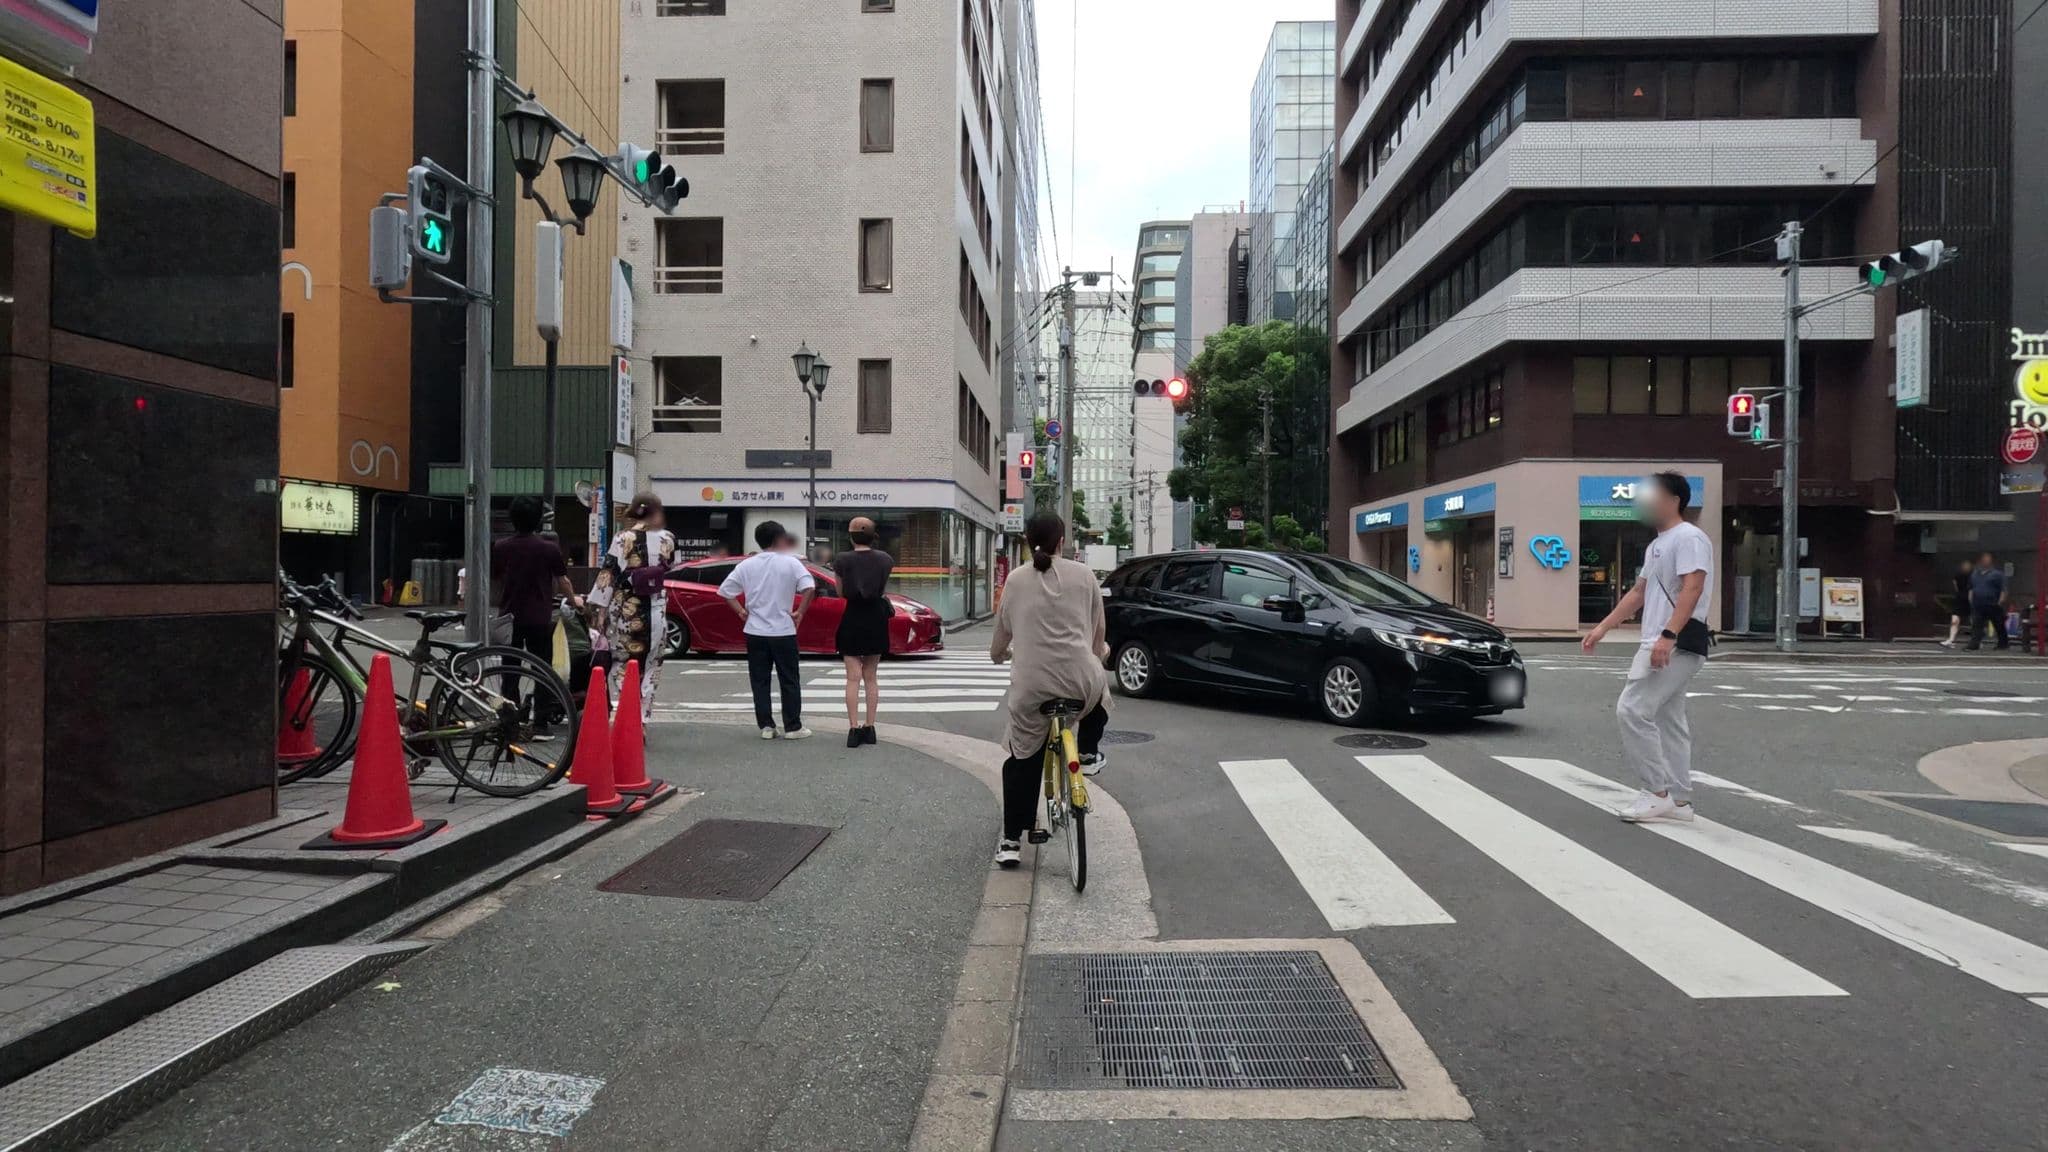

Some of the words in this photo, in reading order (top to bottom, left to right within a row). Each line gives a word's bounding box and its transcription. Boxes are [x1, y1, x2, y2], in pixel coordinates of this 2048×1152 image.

[350, 440, 399, 480] on
[731, 491, 785, 501] 処方せん調剤
[840, 489, 889, 503] pharmacy
